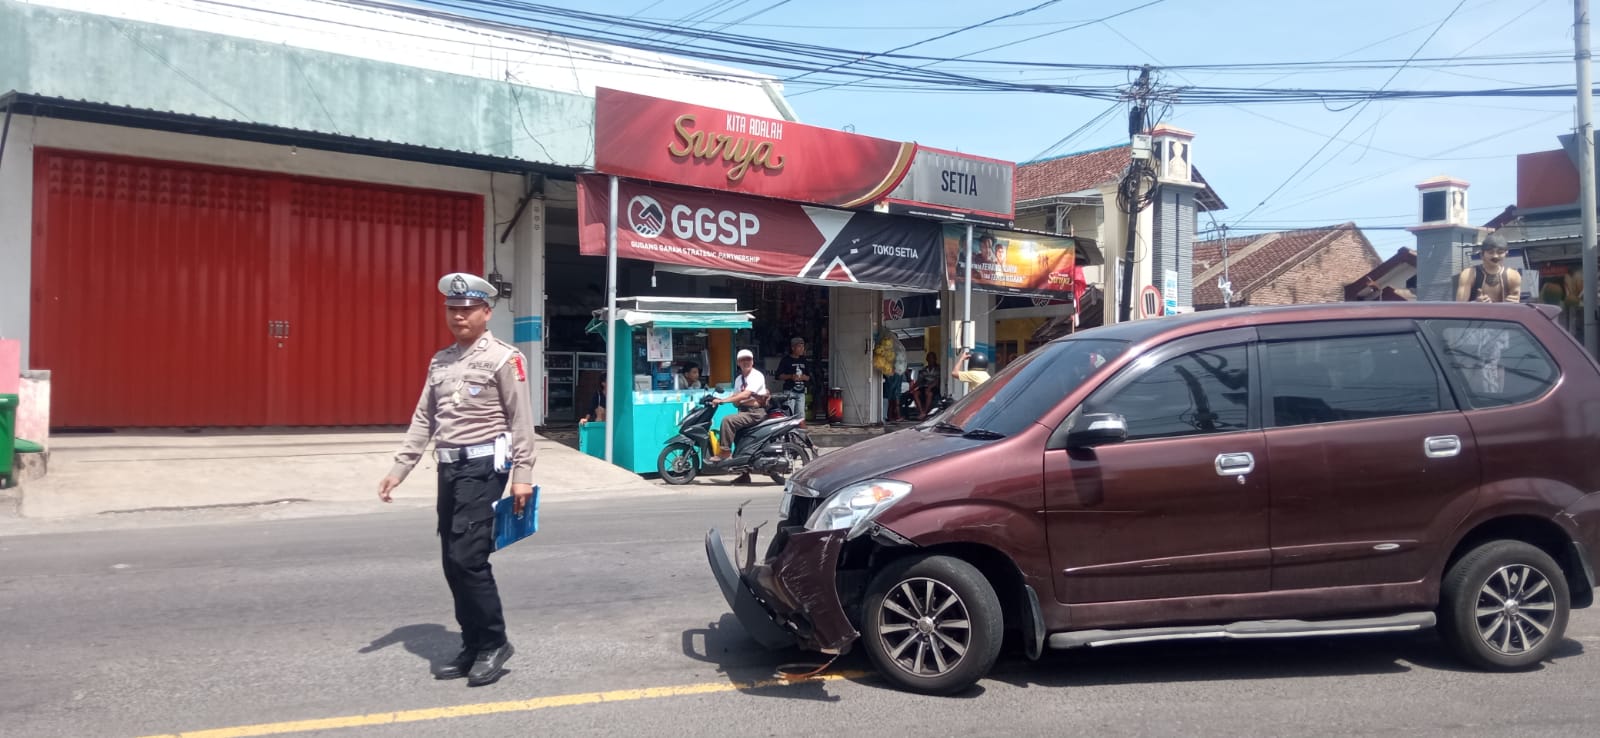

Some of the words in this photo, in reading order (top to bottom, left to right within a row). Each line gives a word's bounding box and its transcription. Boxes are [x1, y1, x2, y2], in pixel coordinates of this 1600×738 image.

[726, 113, 746, 133] KITA
[749, 118, 783, 140] ADALAH
[668, 114, 785, 181] Surya
[941, 170, 978, 196] SETIA
[671, 204, 760, 247] GGSP
[630, 241, 659, 250] GUDANG
[659, 244, 682, 254] GARAM
[718, 251, 761, 264] PARTNERSHIP
[872, 244, 895, 256] TOKO
[895, 246, 919, 259] SETIA
